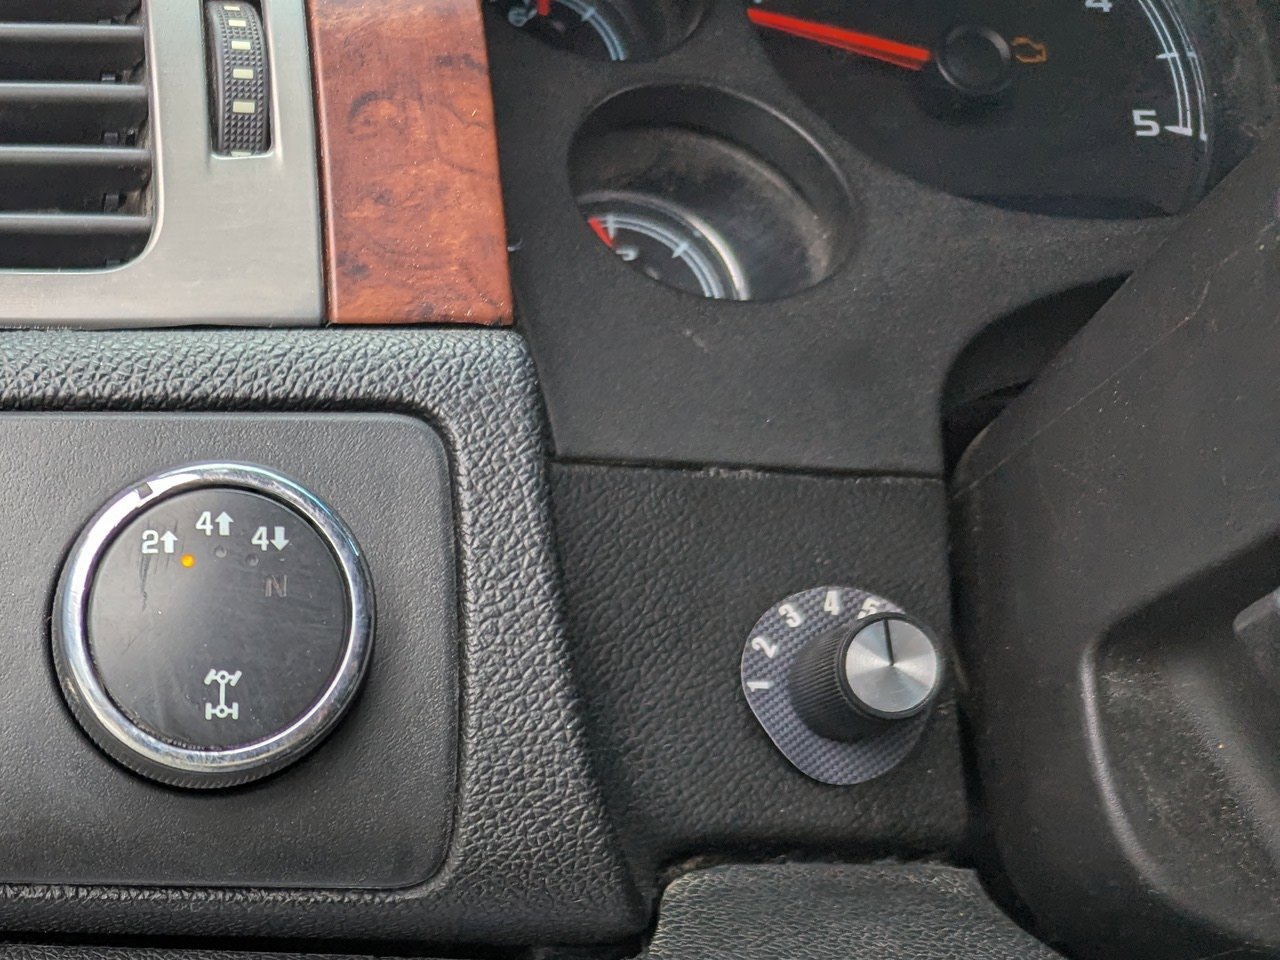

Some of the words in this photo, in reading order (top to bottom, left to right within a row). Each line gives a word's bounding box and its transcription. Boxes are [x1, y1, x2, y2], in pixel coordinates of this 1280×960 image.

[1132, 109, 1160, 137] 5
[195, 510, 213, 536] 4
[141, 529, 159, 554] 2
[251, 525, 269, 551] 4
[264, 574, 288, 598] N
[823, 590, 840, 616] 4
[857, 596, 881, 620] 5
[778, 603, 802, 629] 3
[751, 637, 778, 659] 2
[746, 680, 774, 692] 1
